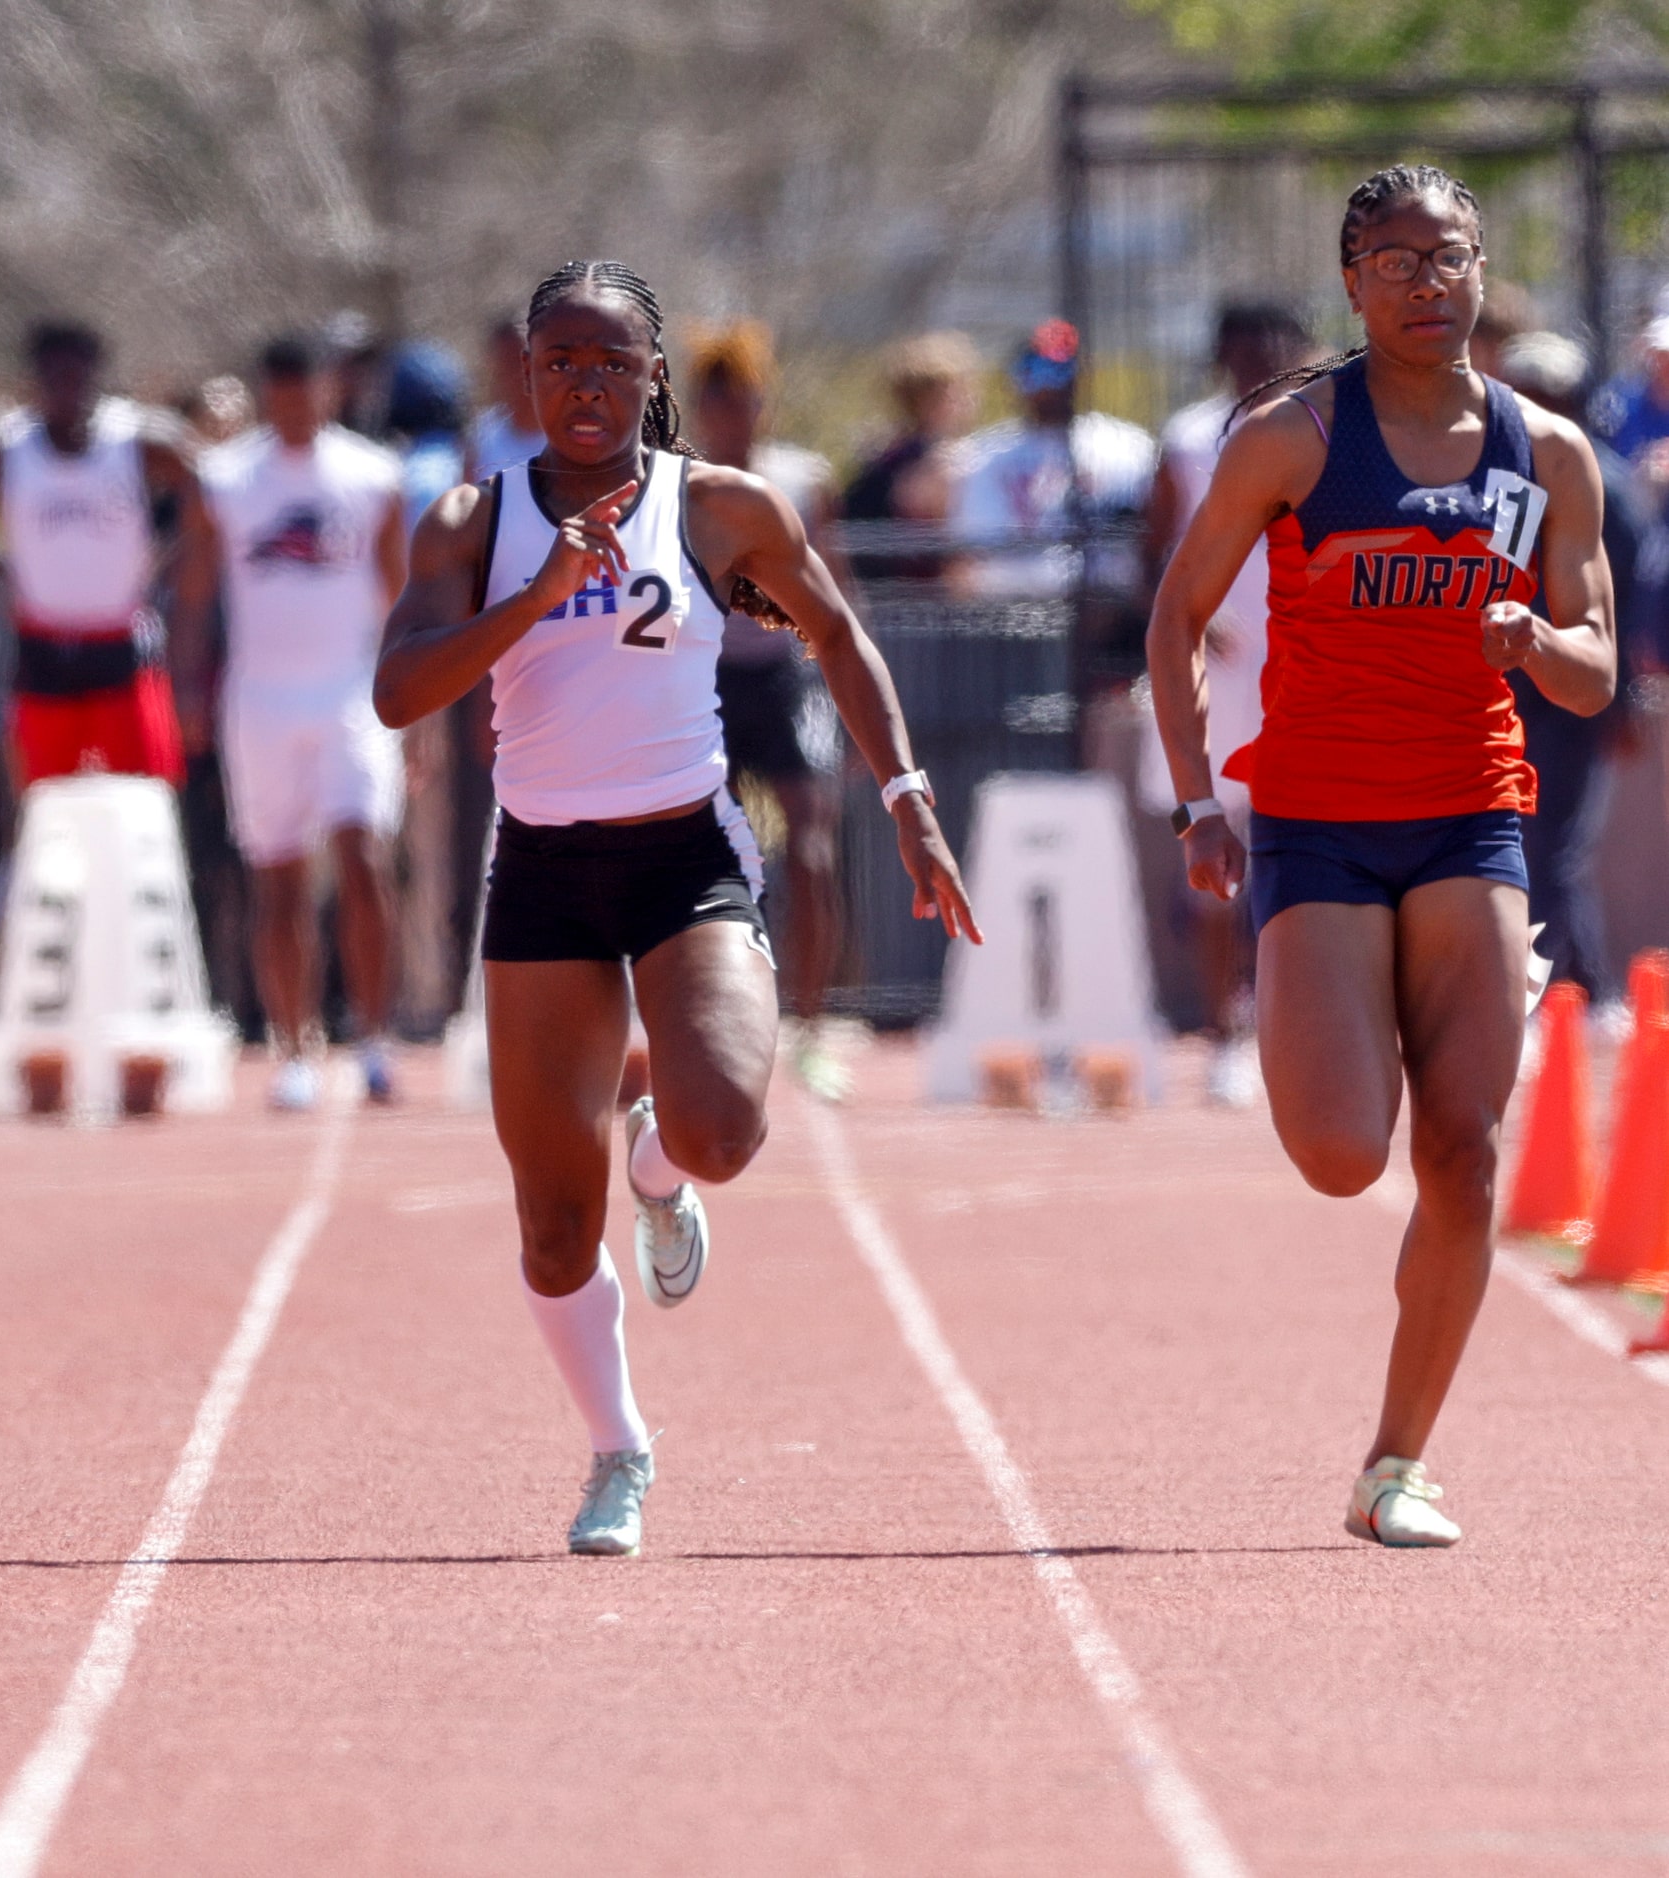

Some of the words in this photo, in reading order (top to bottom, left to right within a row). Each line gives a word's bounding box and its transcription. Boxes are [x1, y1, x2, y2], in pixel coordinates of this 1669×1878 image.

[1506, 487, 1531, 558] 1
[523, 573, 618, 622] H
[622, 575, 672, 649] 2
[1350, 551, 1516, 610] NORTH
[1024, 882, 1062, 1019] 1
